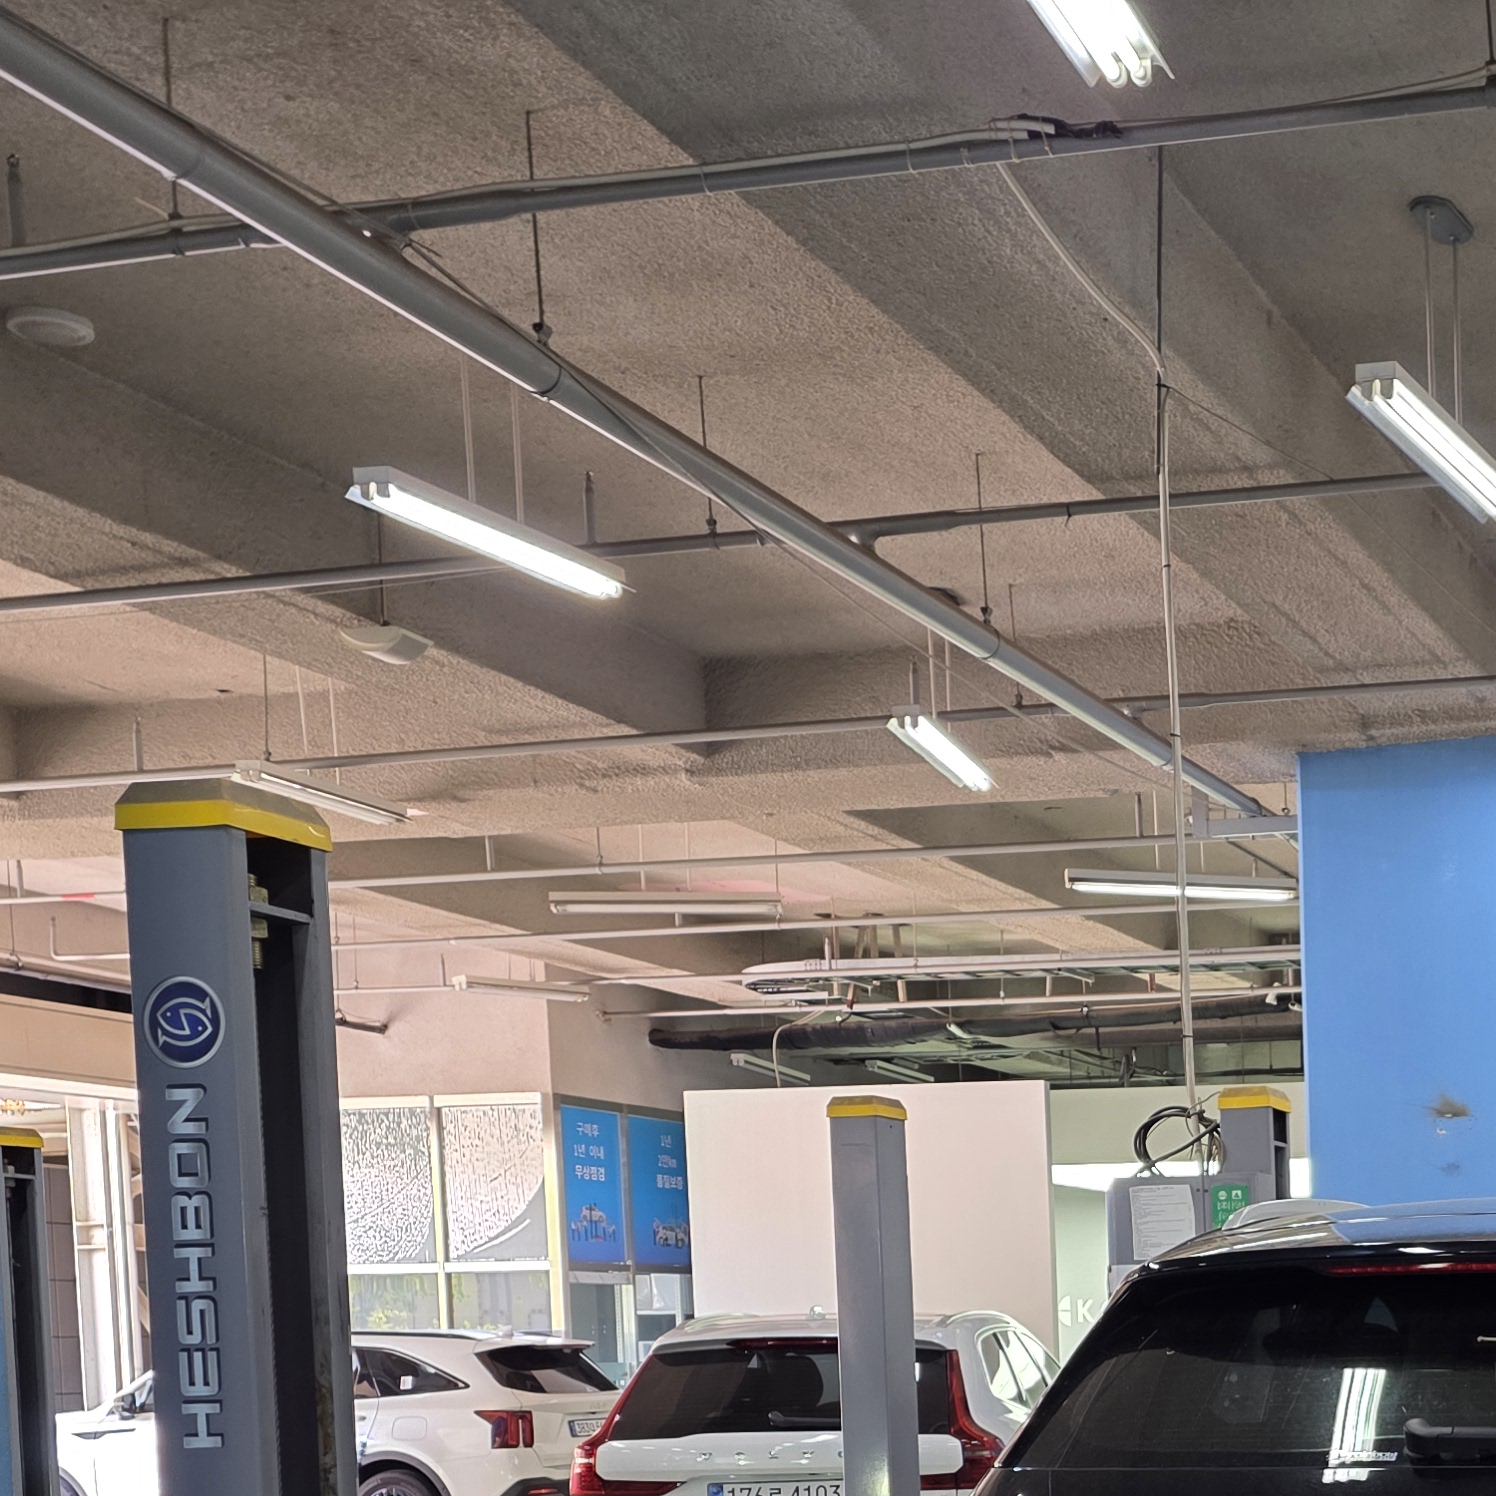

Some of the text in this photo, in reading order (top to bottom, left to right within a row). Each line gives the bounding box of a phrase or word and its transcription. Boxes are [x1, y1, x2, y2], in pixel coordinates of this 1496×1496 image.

[660, 1134, 672, 1148] 1년
[573, 1144, 605, 1160] 1년 이내
[574, 1164, 606, 1182] 무상점검
[656, 1174, 684, 1190] 품질보증
[165, 1084, 224, 1449] HESHBON
